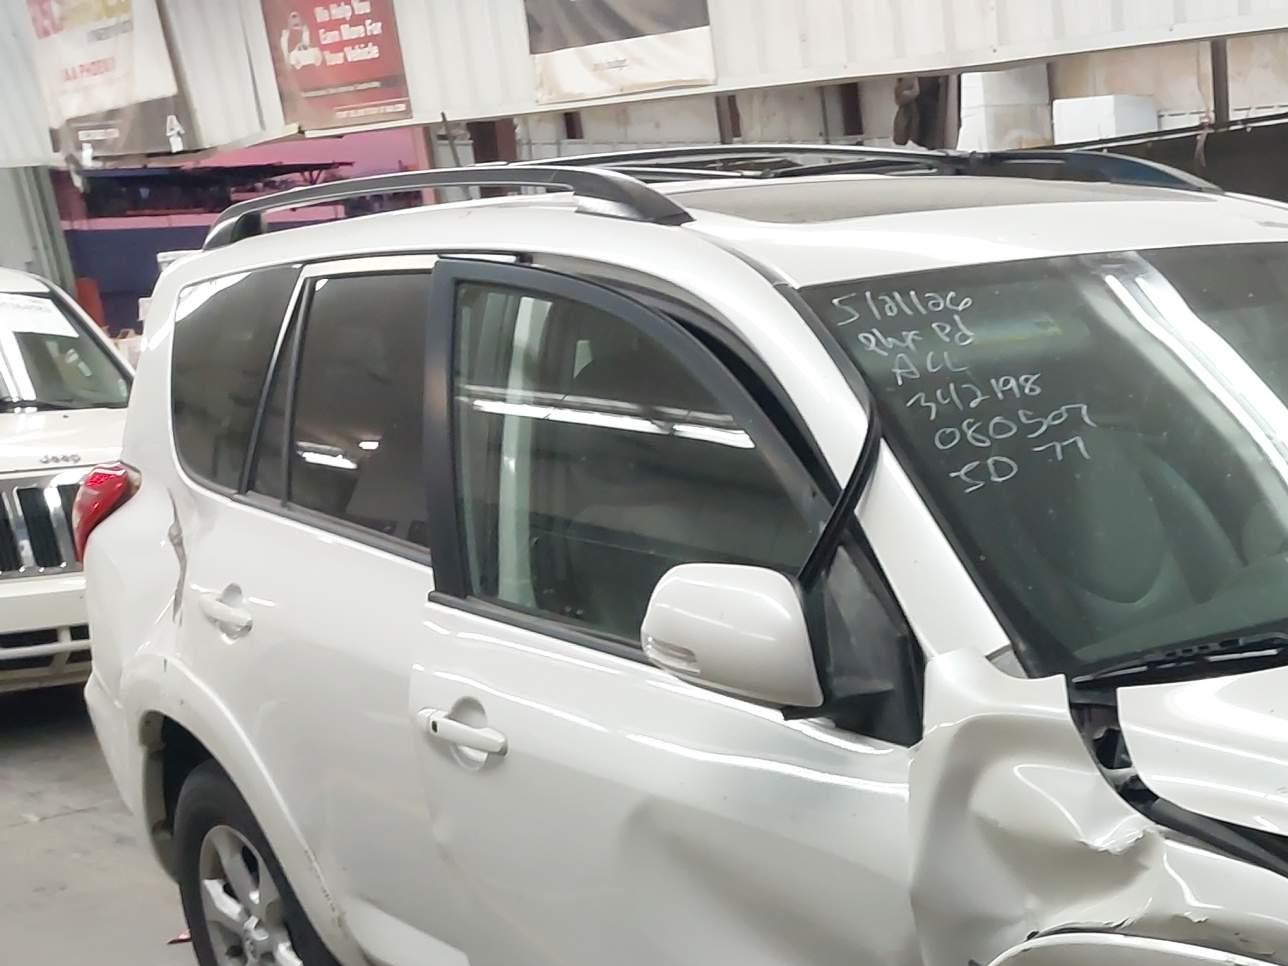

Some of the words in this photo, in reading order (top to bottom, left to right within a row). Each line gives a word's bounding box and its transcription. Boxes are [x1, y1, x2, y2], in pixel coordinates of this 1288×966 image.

[340, 24, 365, 41] More
[365, 19, 382, 36] For
[343, 42, 380, 62] Vehicle
[831, 290, 973, 326] 5/21/26
[906, 373, 1042, 420] 342198
